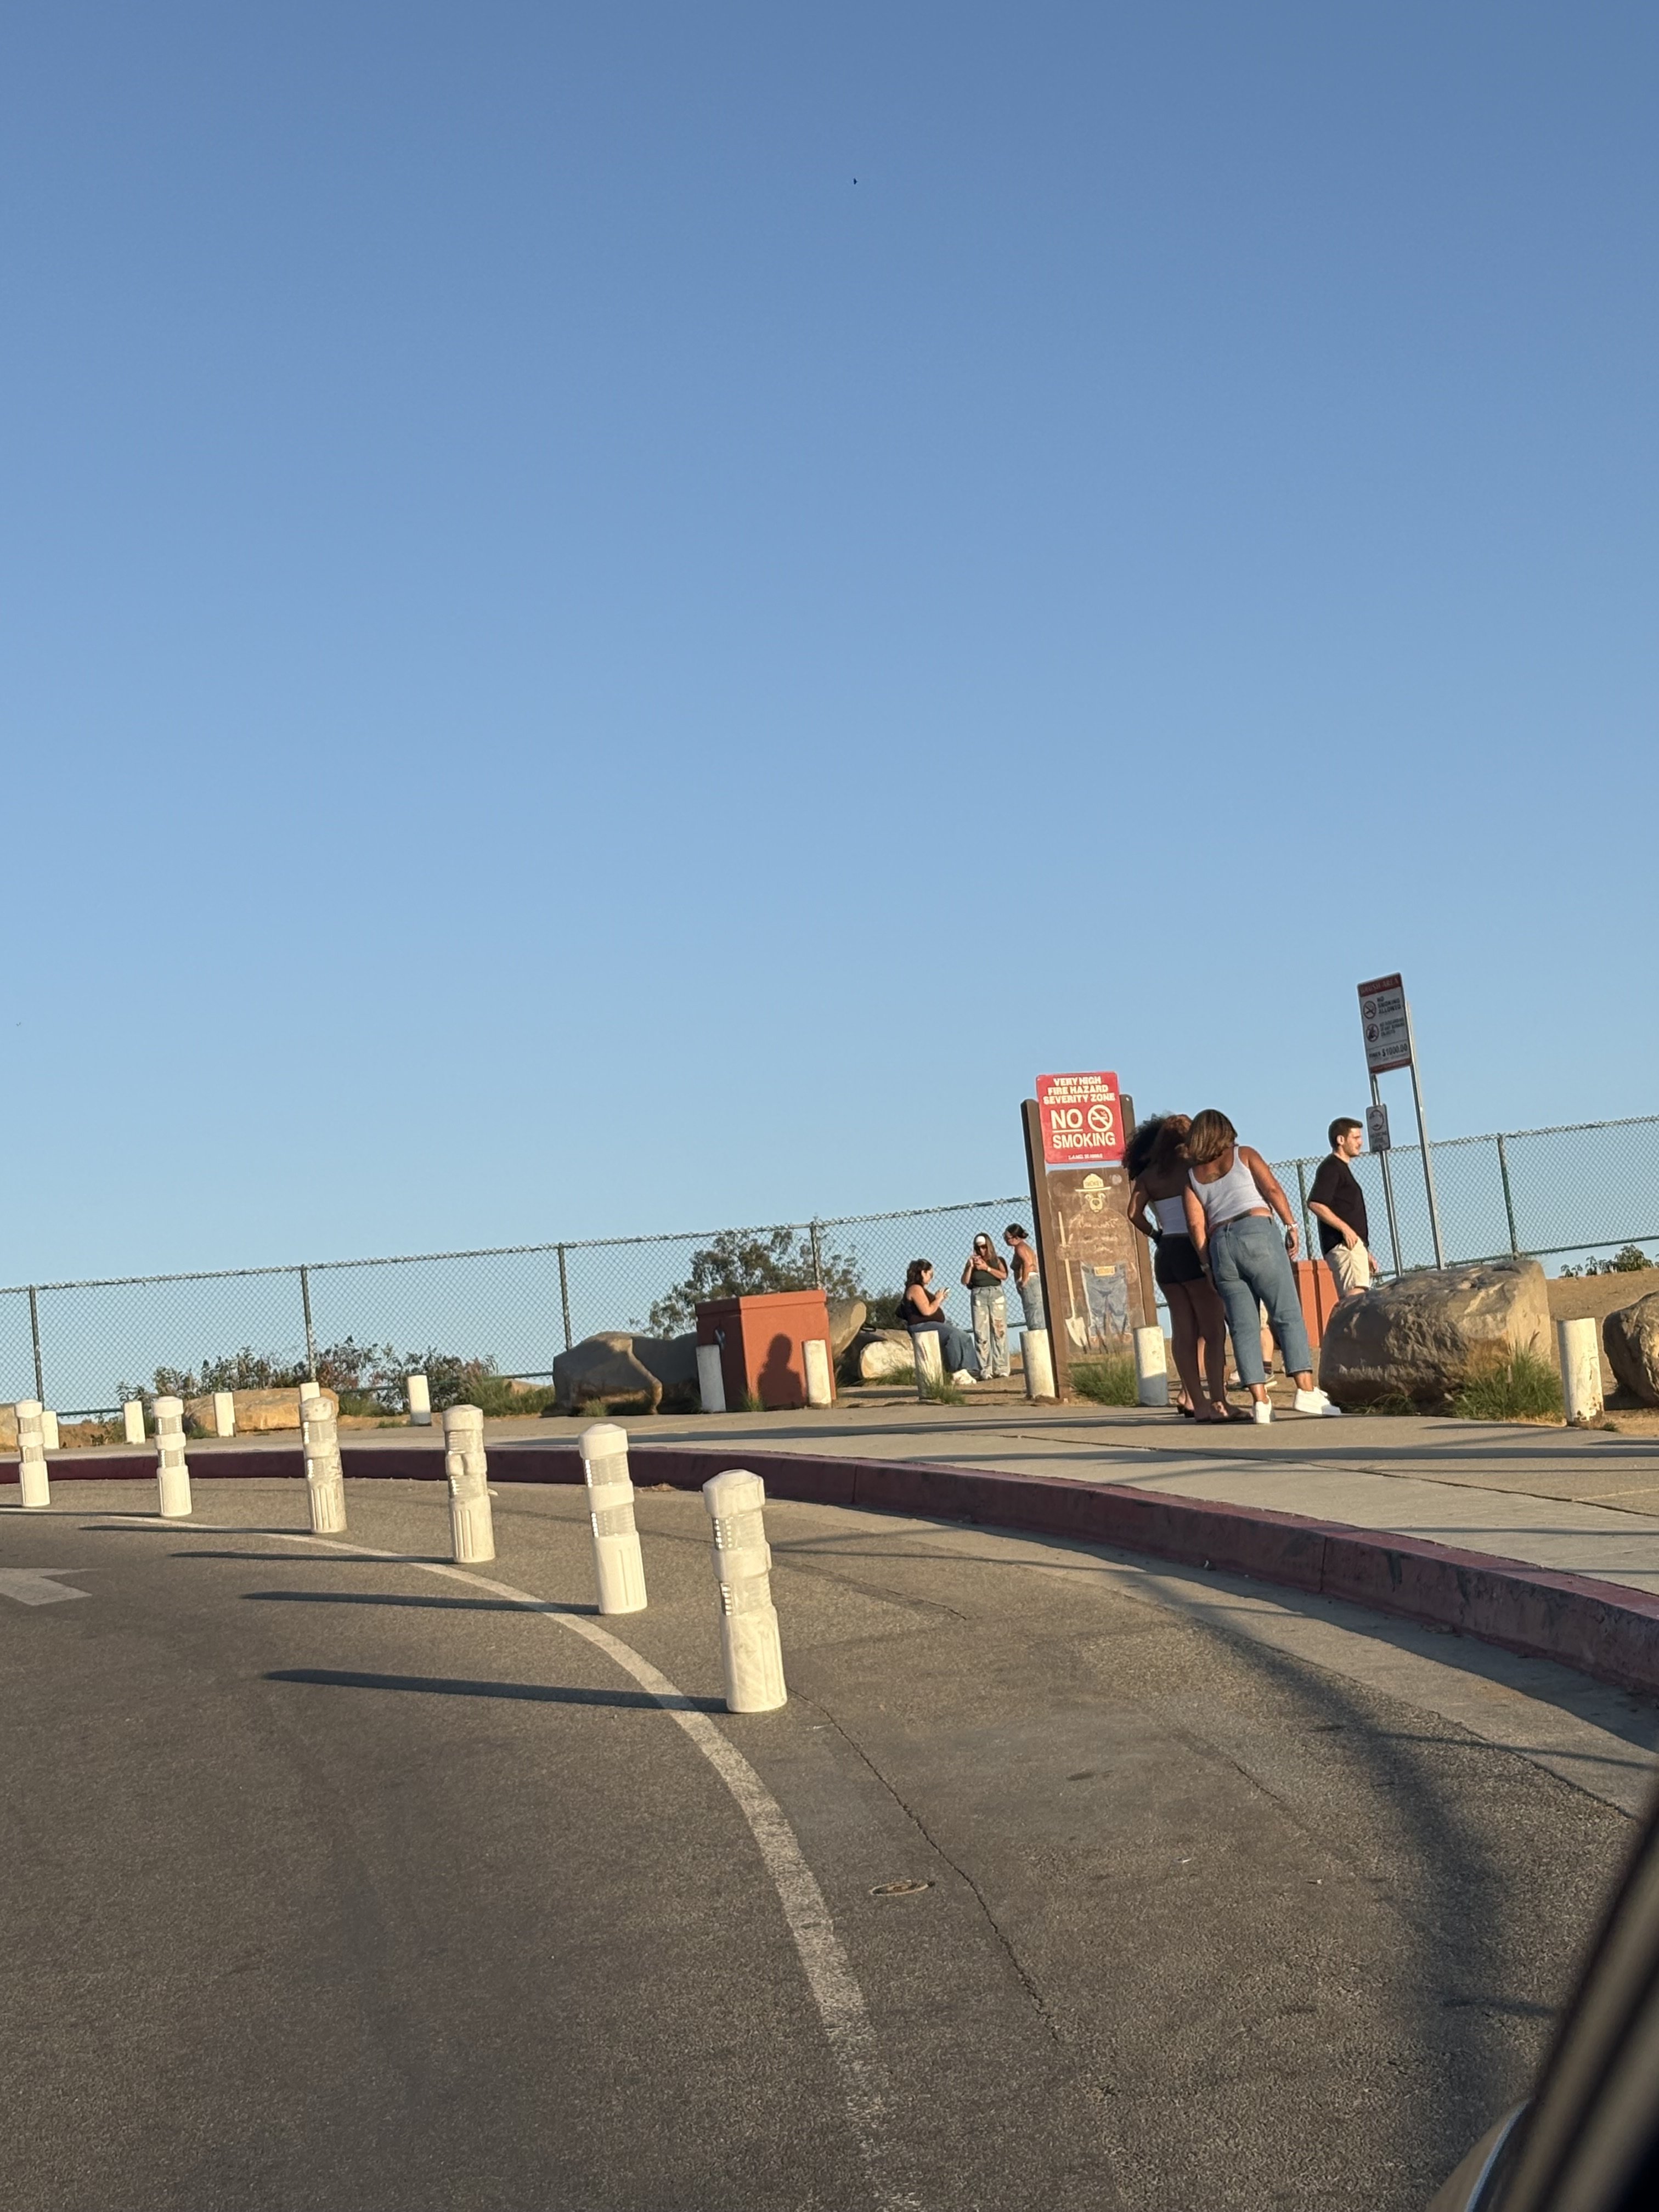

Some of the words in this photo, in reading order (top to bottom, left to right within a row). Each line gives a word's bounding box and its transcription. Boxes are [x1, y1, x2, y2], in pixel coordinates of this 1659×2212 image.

[1378, 998, 1400, 1008] SMOKING
[1378, 1004, 1401, 1014] ALLOWED
[1381, 1043, 1408, 1057] $1000.00
[1053, 1077, 1077, 1086] VERY
[1079, 1076, 1102, 1085] HIGH
[1047, 1087, 1068, 1096] FIRE
[1069, 1084, 1109, 1094] HAZARD
[1043, 1094, 1088, 1105] SEVERITY
[1090, 1092, 1115, 1102] ZONE
[1051, 1108, 1083, 1129] NO
[1053, 1131, 1116, 1149] SMOKING
